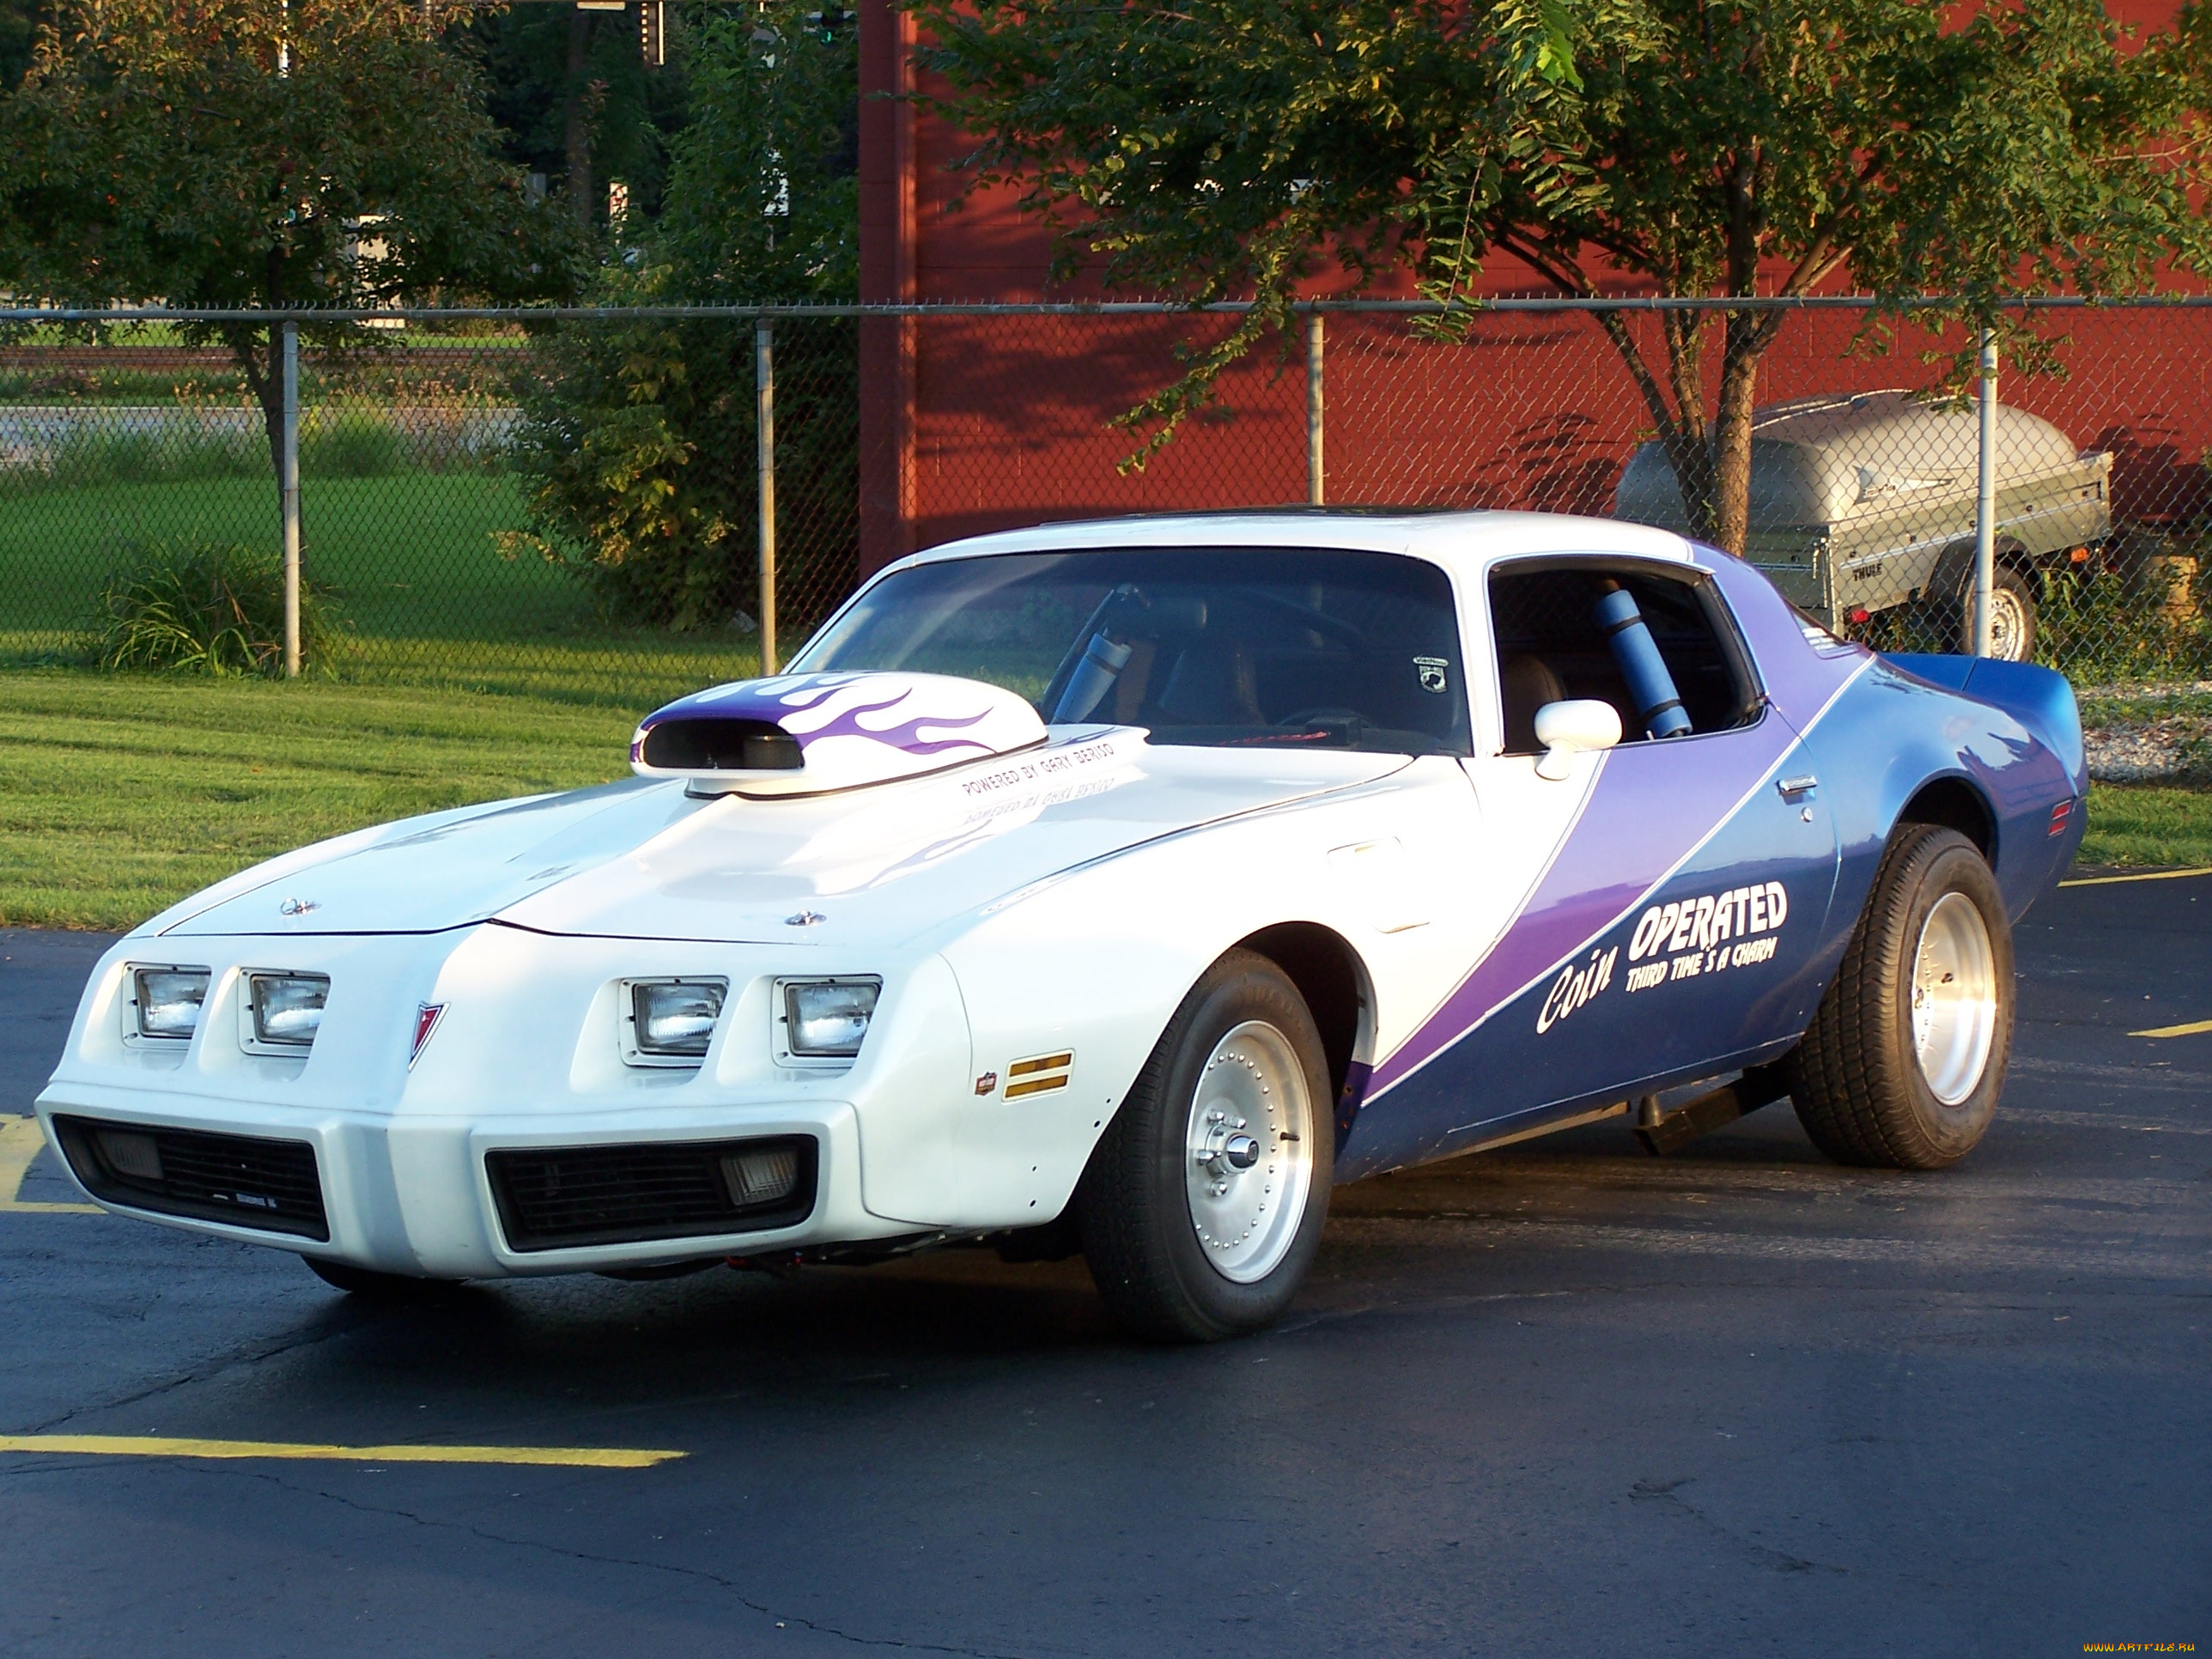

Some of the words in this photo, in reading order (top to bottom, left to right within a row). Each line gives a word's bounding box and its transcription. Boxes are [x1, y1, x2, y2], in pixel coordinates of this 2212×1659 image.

[1852, 563, 1882, 581] THULE
[962, 770, 1020, 796] POWERED
[1021, 765, 1039, 779] BY
[1040, 756, 1073, 773] GARY
[1073, 743, 1115, 763] BERISO
[1628, 881, 1788, 961] OPERATED
[1536, 945, 1619, 1035] Coin
[1626, 961, 1668, 993] THIRD
[1717, 946, 1731, 971] A
[1732, 937, 1778, 968] CHARM
